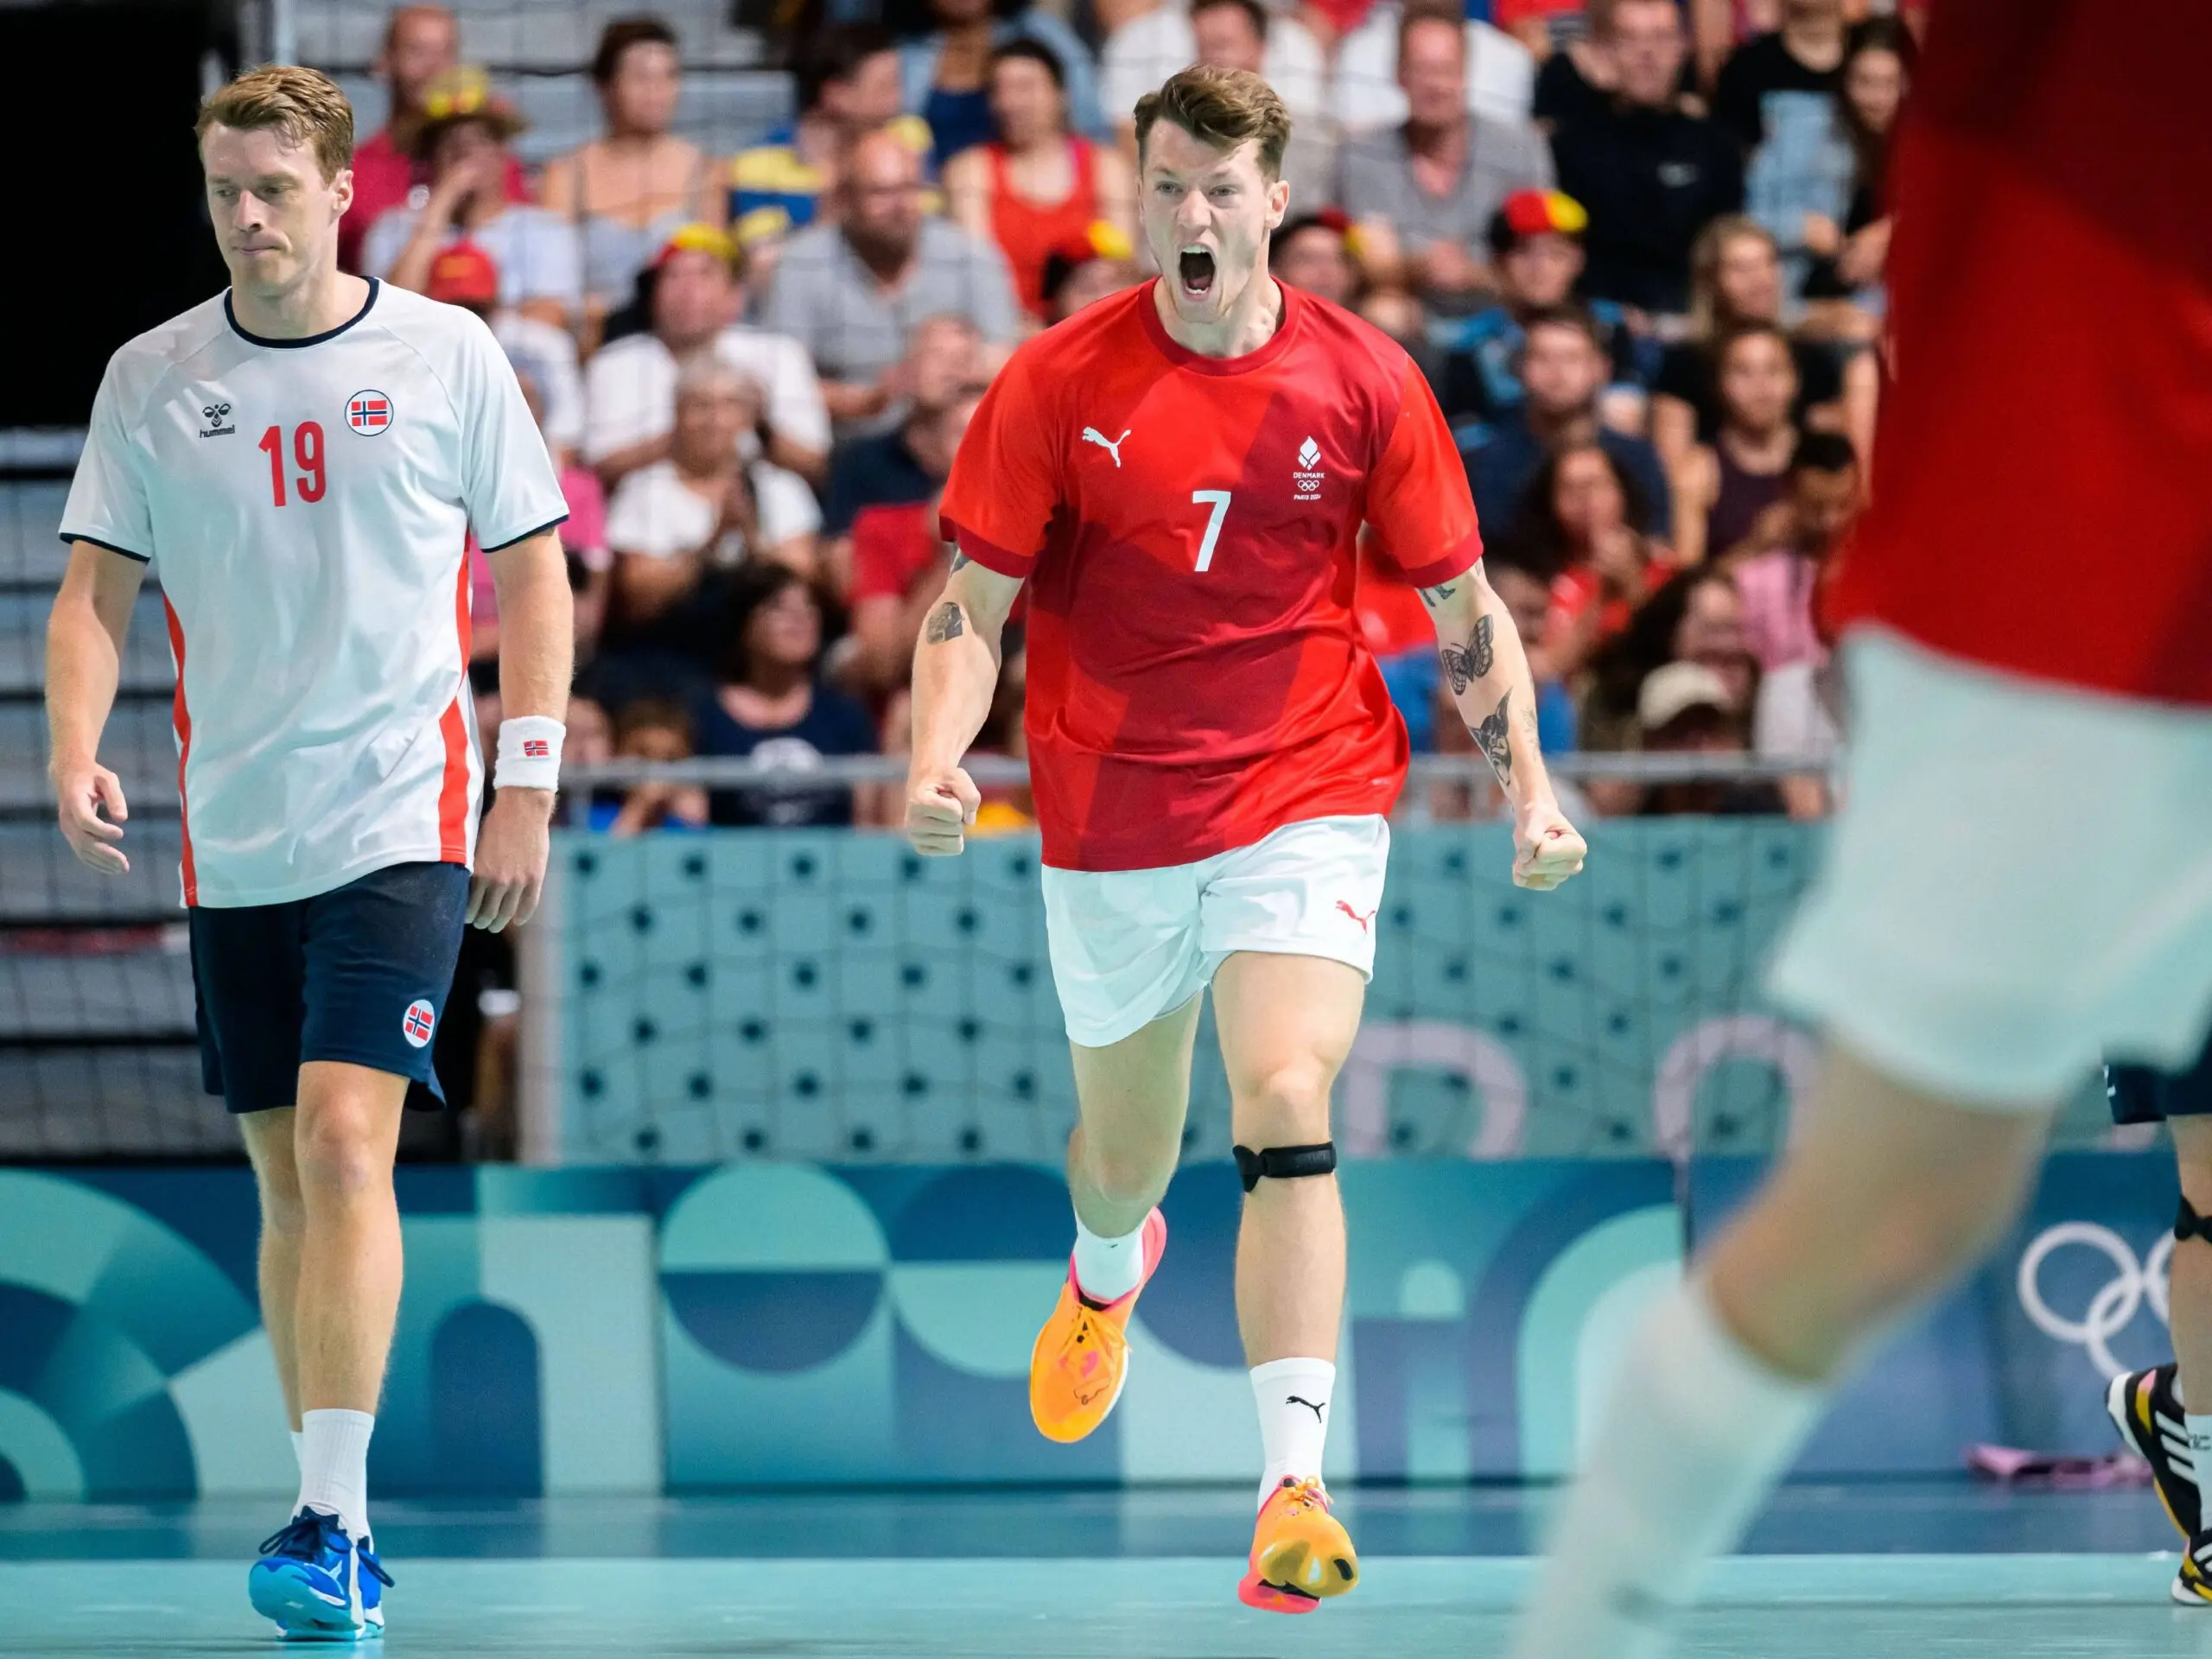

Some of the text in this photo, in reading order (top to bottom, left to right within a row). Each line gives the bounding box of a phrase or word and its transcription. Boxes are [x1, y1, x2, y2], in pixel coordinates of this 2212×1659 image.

[200, 424, 235, 438] hummel
[258, 421, 327, 506] 19
[1192, 490, 1231, 572] 7
